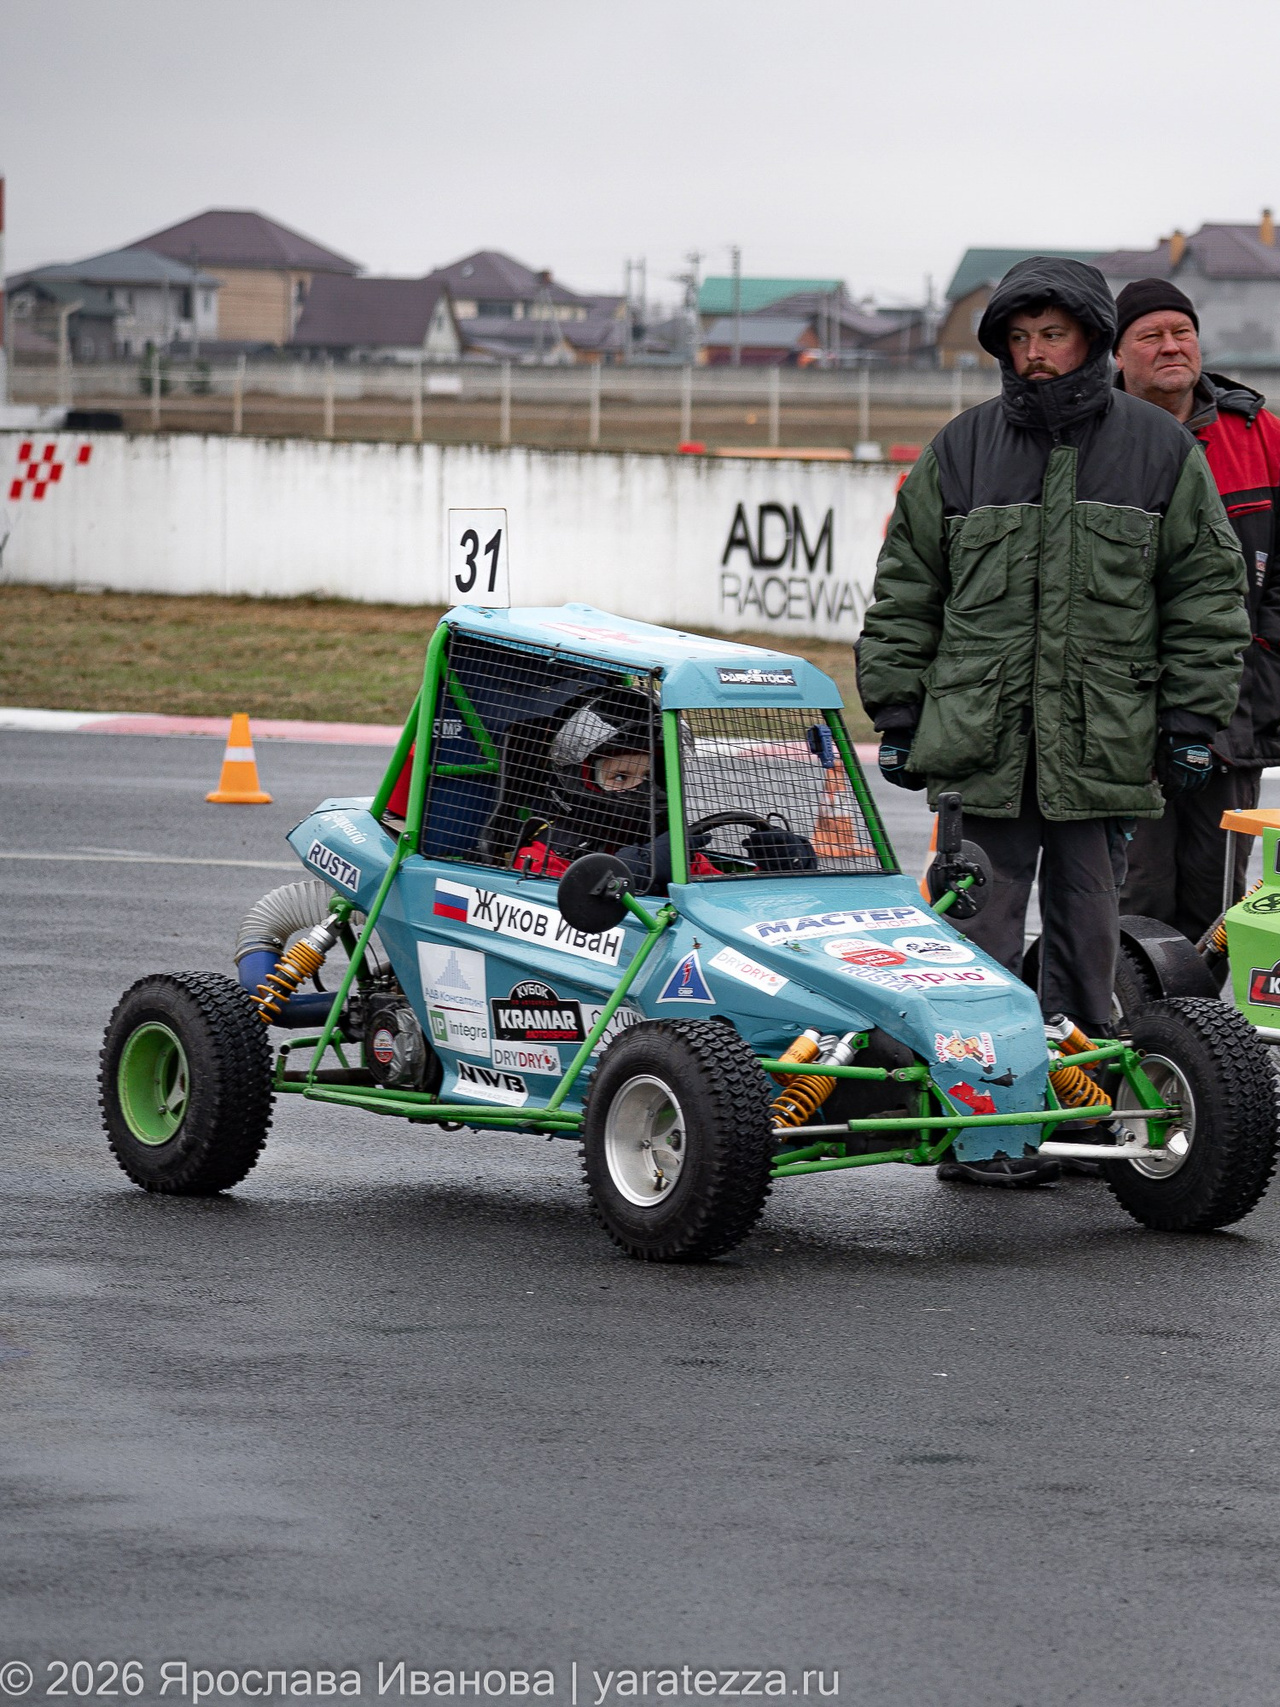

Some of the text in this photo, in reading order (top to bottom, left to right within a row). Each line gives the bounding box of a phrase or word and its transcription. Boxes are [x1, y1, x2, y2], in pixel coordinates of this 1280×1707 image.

[722, 502, 833, 574] ADM
[455, 529, 502, 593] 31
[720, 572, 874, 622] RACEWAY
[309, 842, 358, 890] RUSTA
[473, 888, 620, 958] Жуков Иван
[756, 908, 916, 938] МАСТЕР
[865, 918, 920, 930] СПОРТ
[717, 952, 770, 981] DRYDRY
[516, 984, 549, 999] КУБОК
[449, 1020, 488, 1041] integra
[498, 1009, 578, 1030] KRAMAR
[494, 1049, 544, 1070] DRYDRY
[458, 1062, 526, 1093] NWB
